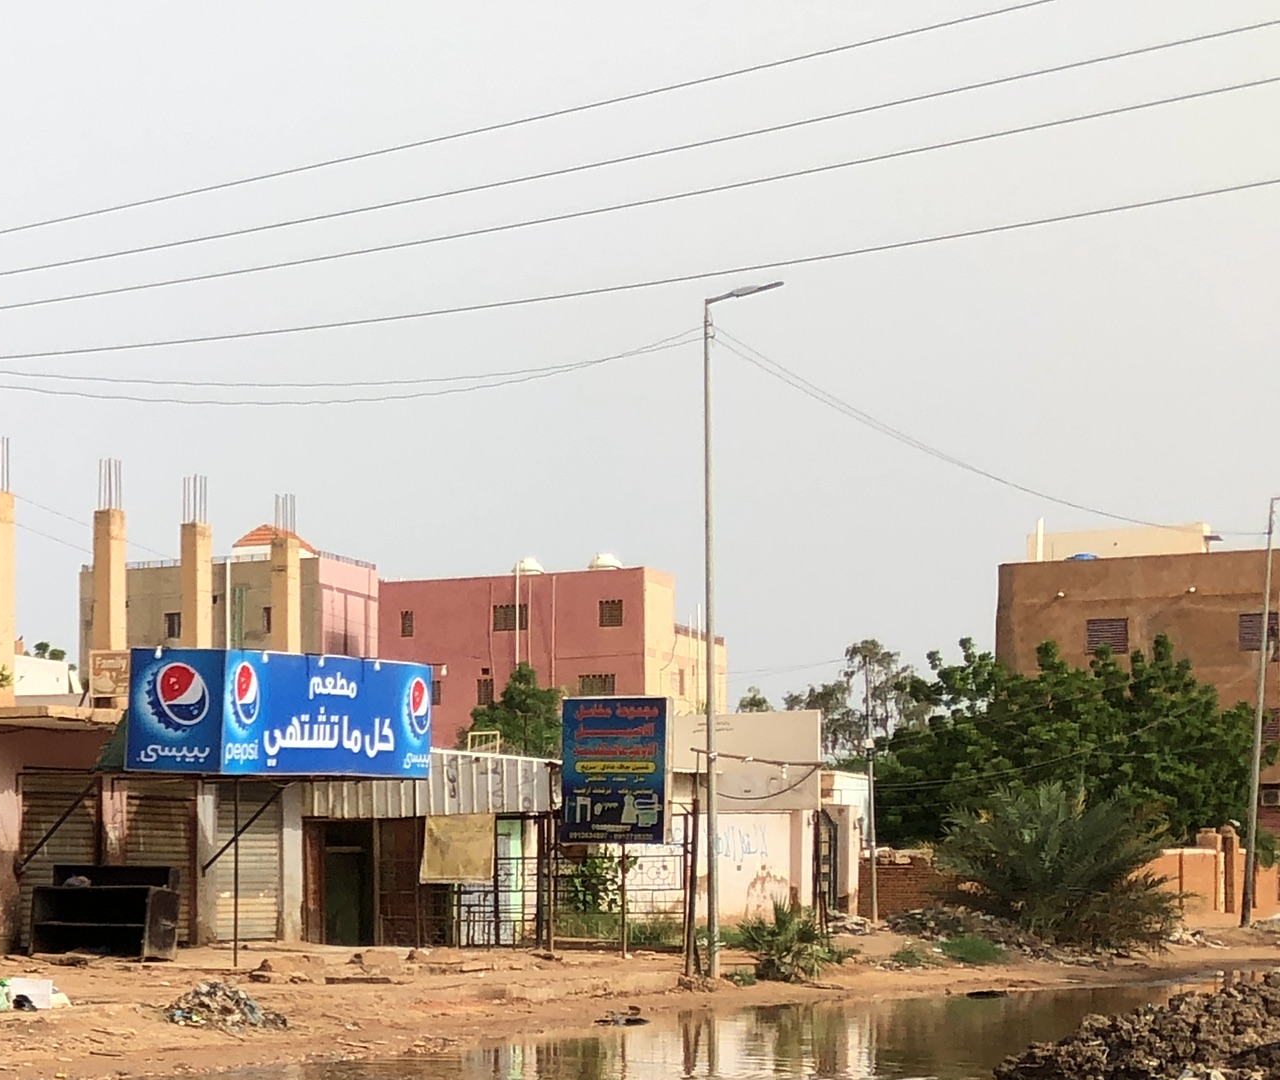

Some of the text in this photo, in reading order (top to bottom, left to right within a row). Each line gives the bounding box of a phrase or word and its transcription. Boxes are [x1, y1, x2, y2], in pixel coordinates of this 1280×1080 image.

[308, 671, 358, 700] مطعم
[263, 706, 396, 767] كل ما تشتهي
[225, 738, 259, 765] pepsi
